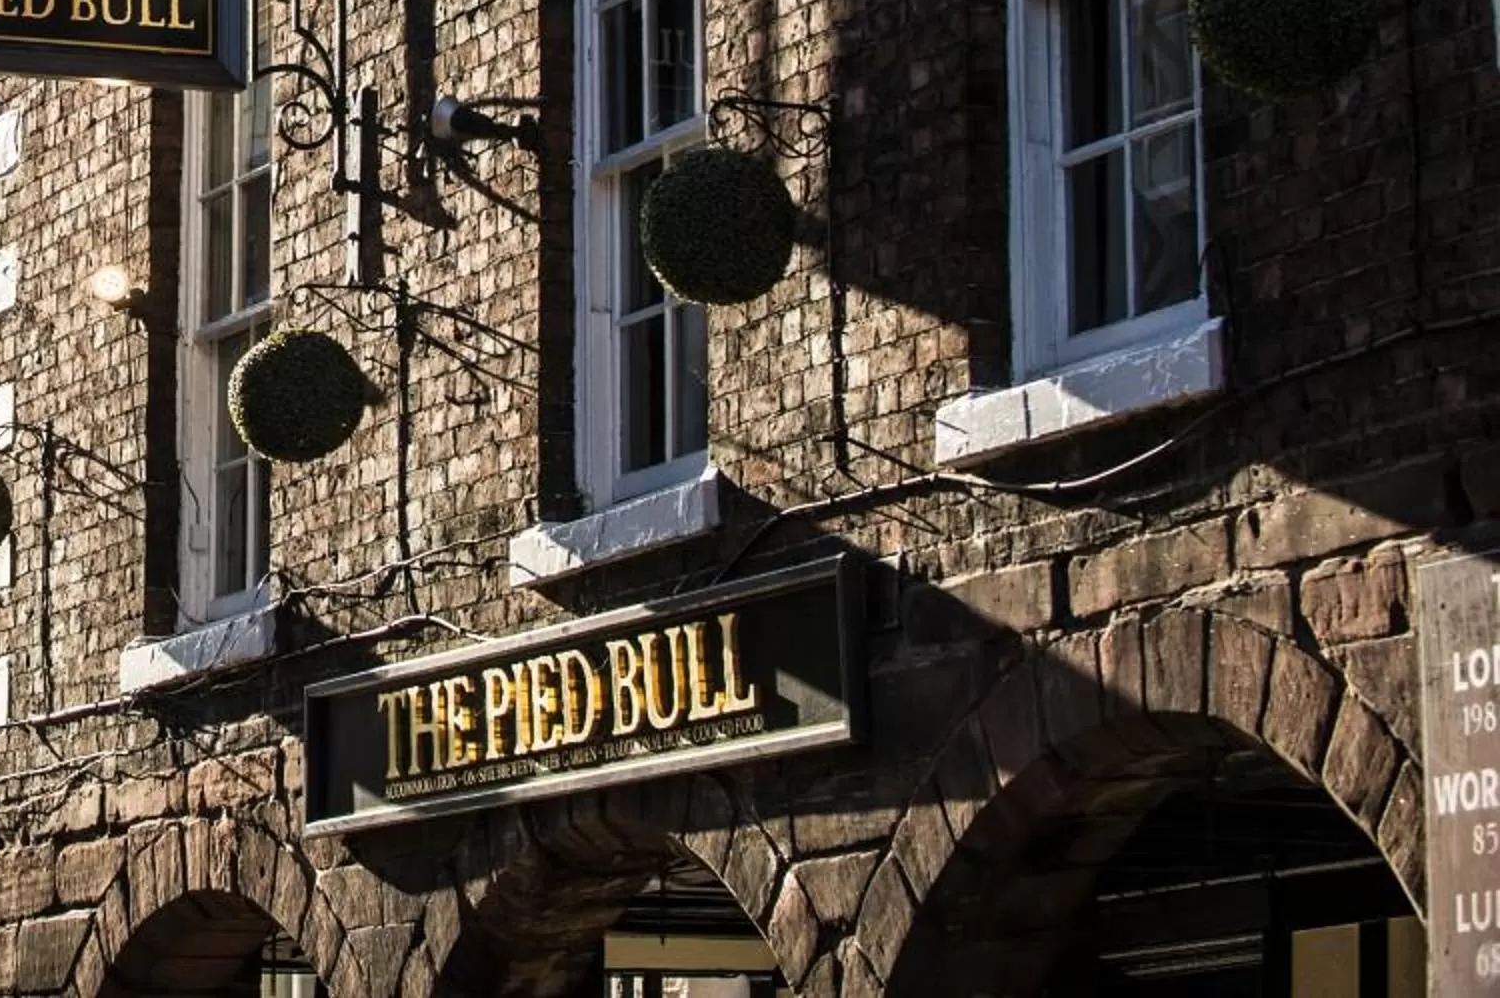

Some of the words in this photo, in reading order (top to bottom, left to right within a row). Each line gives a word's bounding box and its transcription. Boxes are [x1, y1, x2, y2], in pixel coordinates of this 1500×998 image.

[378, 674, 476, 778] THE
[482, 648, 600, 760] PIED
[607, 613, 755, 735] BULL
[735, 712, 764, 734] FOOD
[1462, 701, 1497, 737] 198
